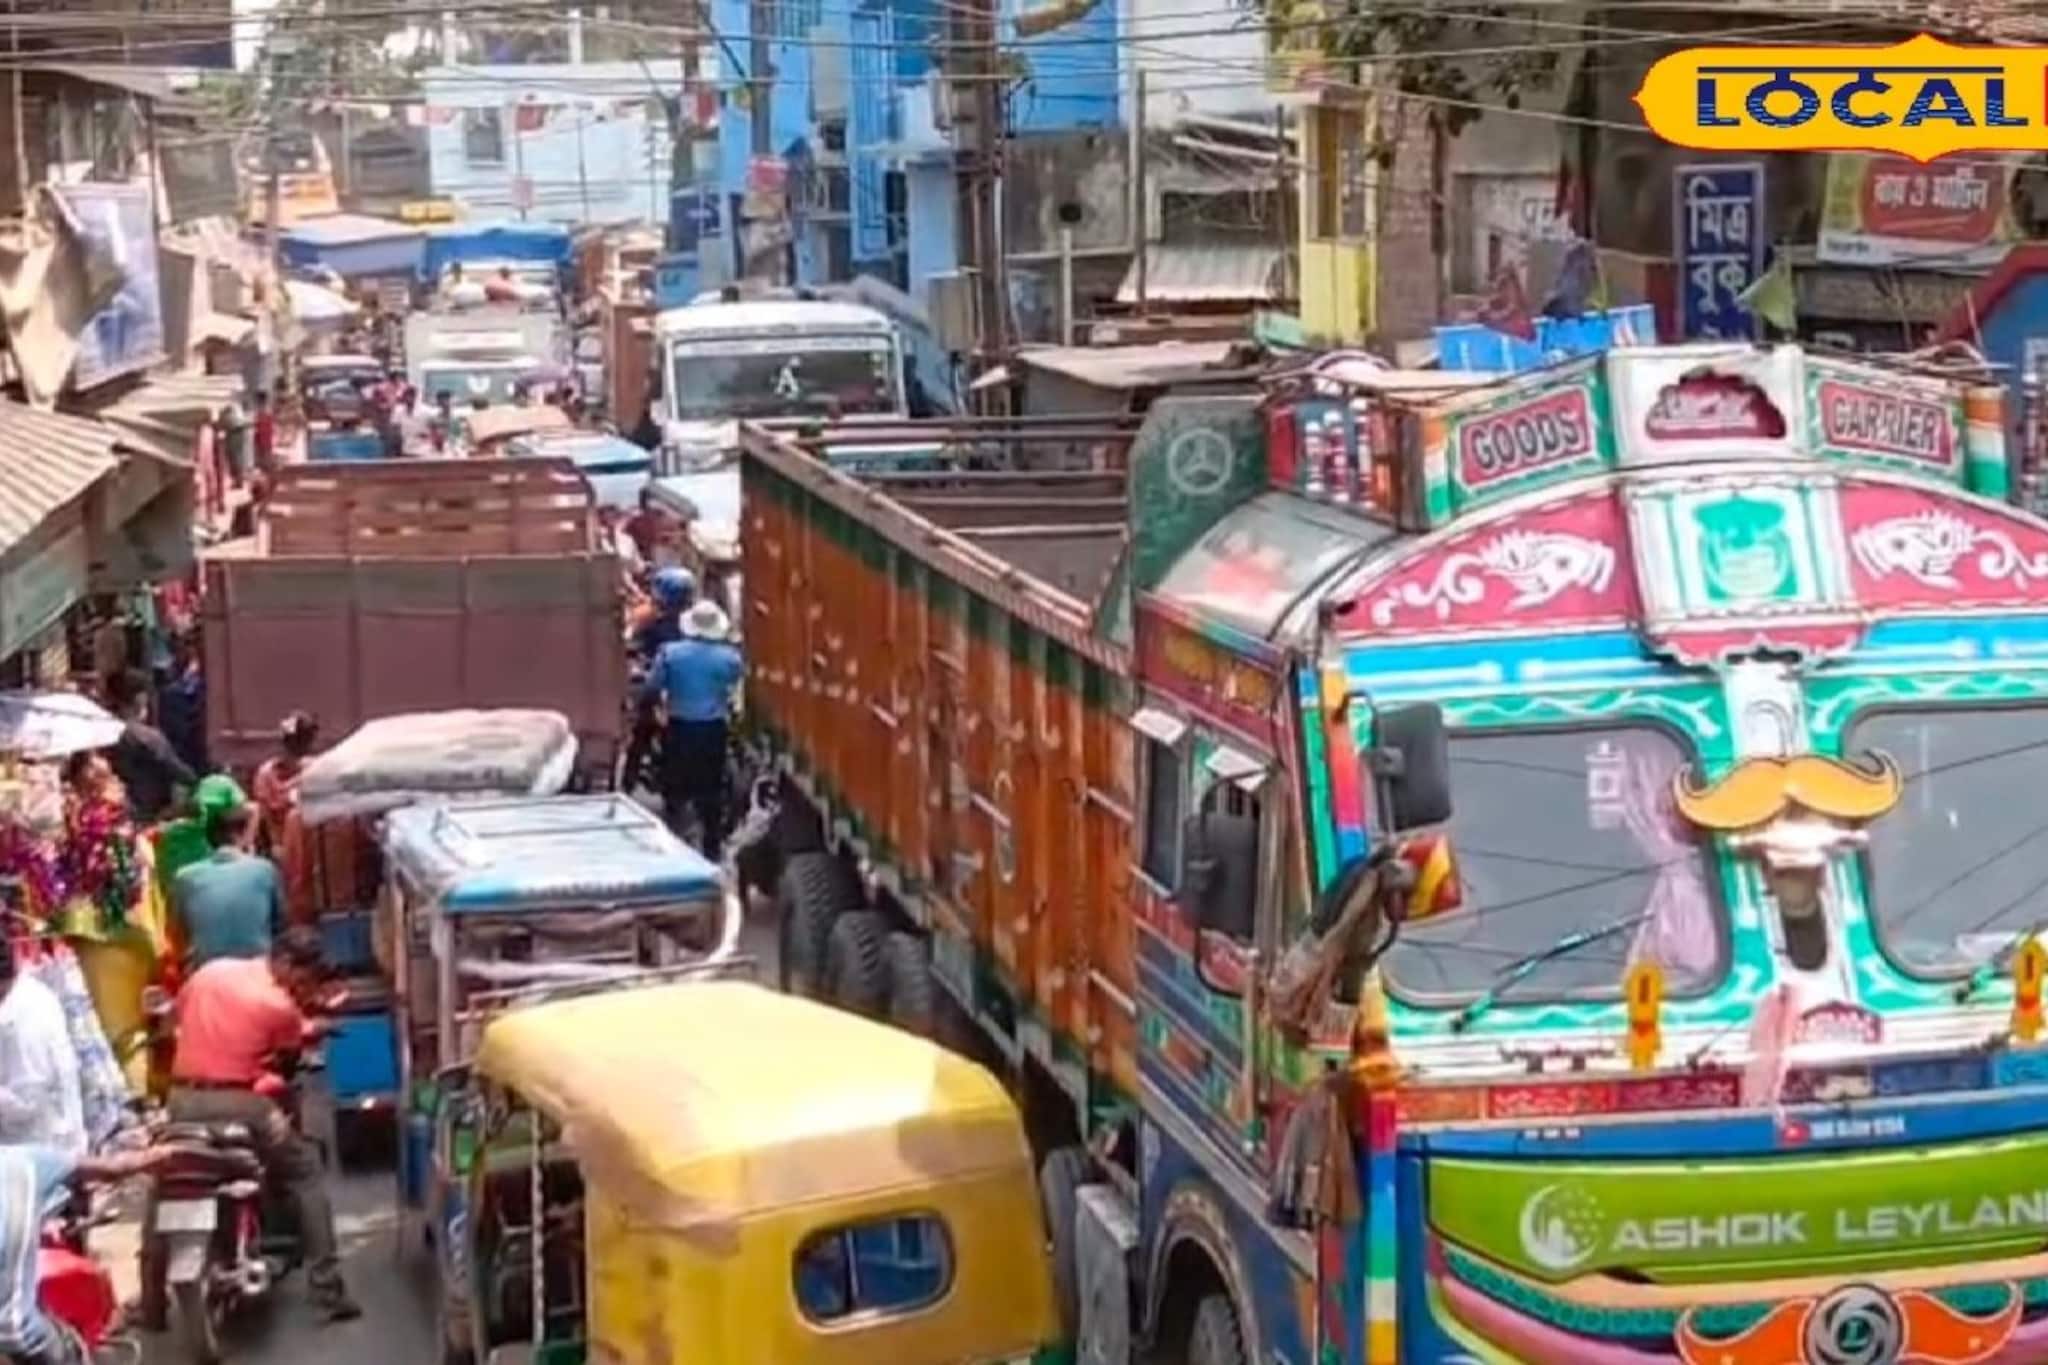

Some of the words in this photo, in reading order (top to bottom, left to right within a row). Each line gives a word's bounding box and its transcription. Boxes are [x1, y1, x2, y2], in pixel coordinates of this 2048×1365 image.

[1469, 402, 1582, 471] GOODS
[1831, 394, 1942, 453] CARRIER
[1612, 1211, 1806, 1252] ASHOK
[1835, 1189, 2048, 1241] LEYLAN
